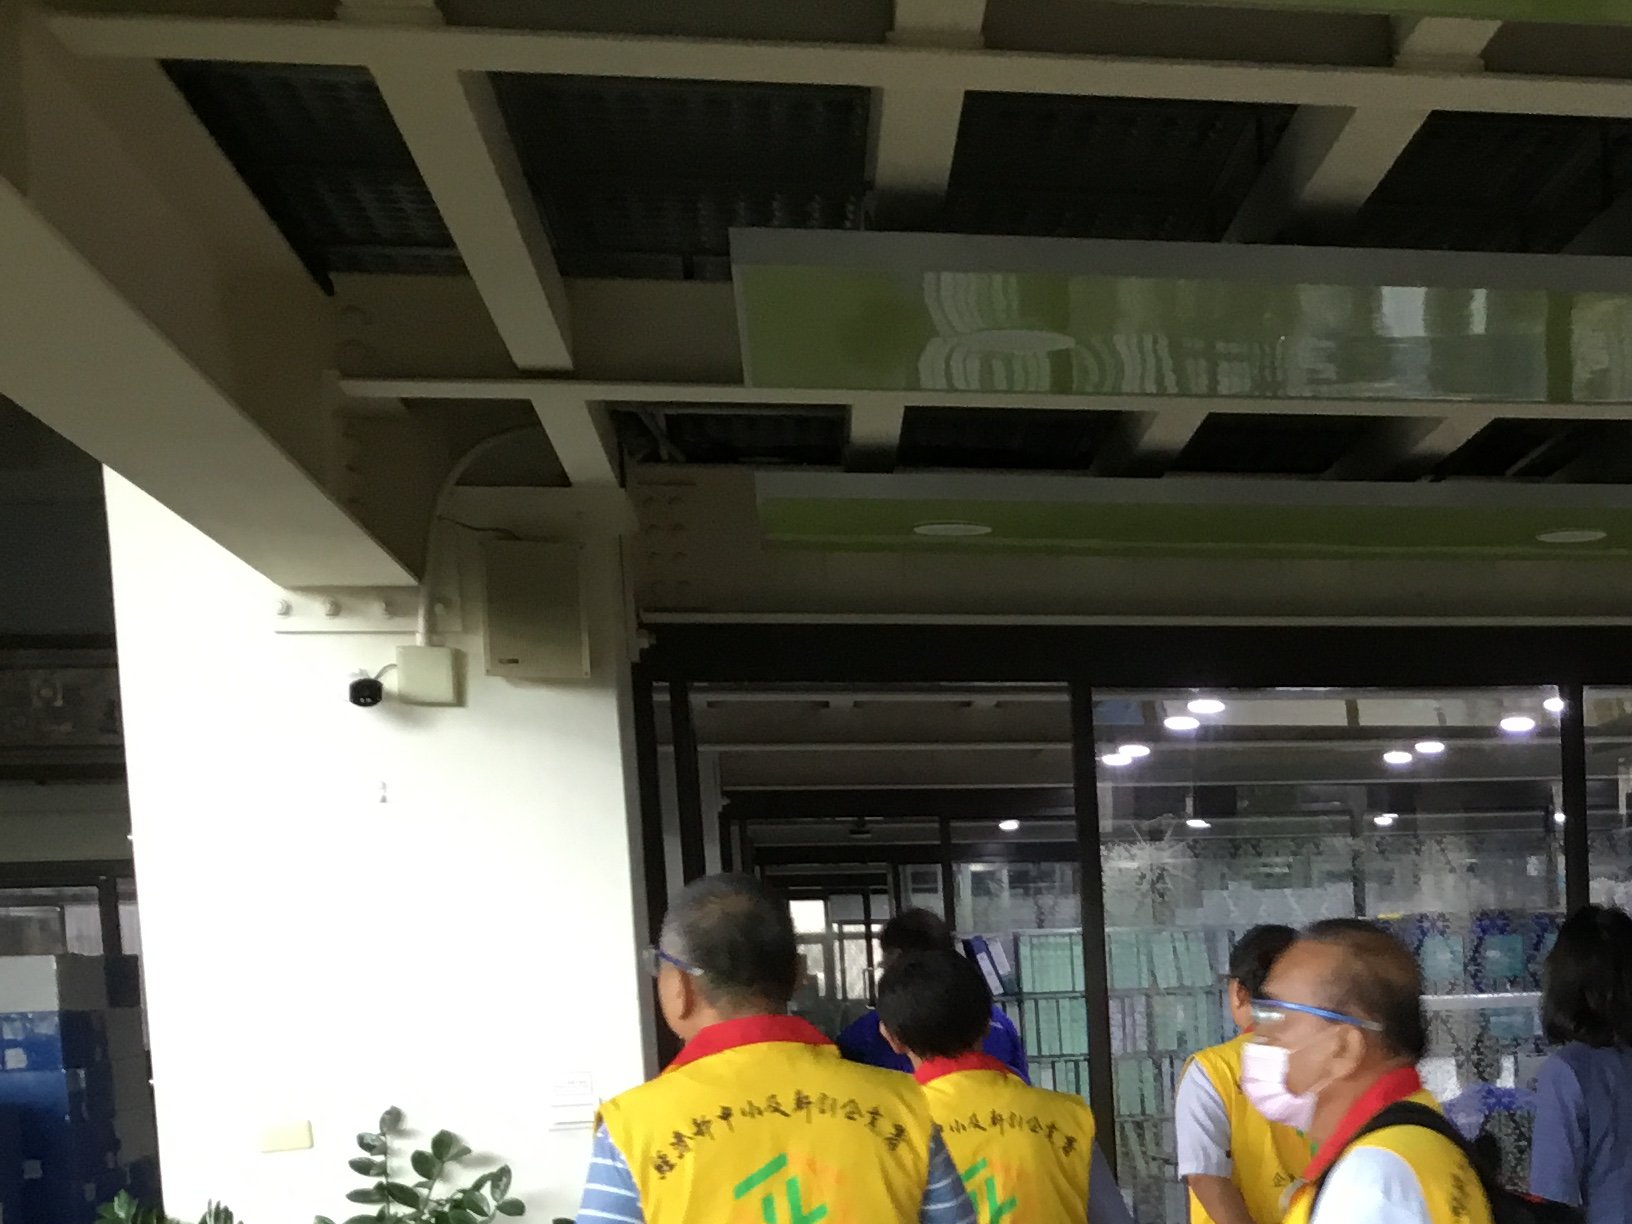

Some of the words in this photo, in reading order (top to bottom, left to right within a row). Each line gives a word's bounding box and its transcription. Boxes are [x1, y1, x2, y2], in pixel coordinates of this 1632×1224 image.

[936, 1108, 1078, 1158] 小及新創企業署
